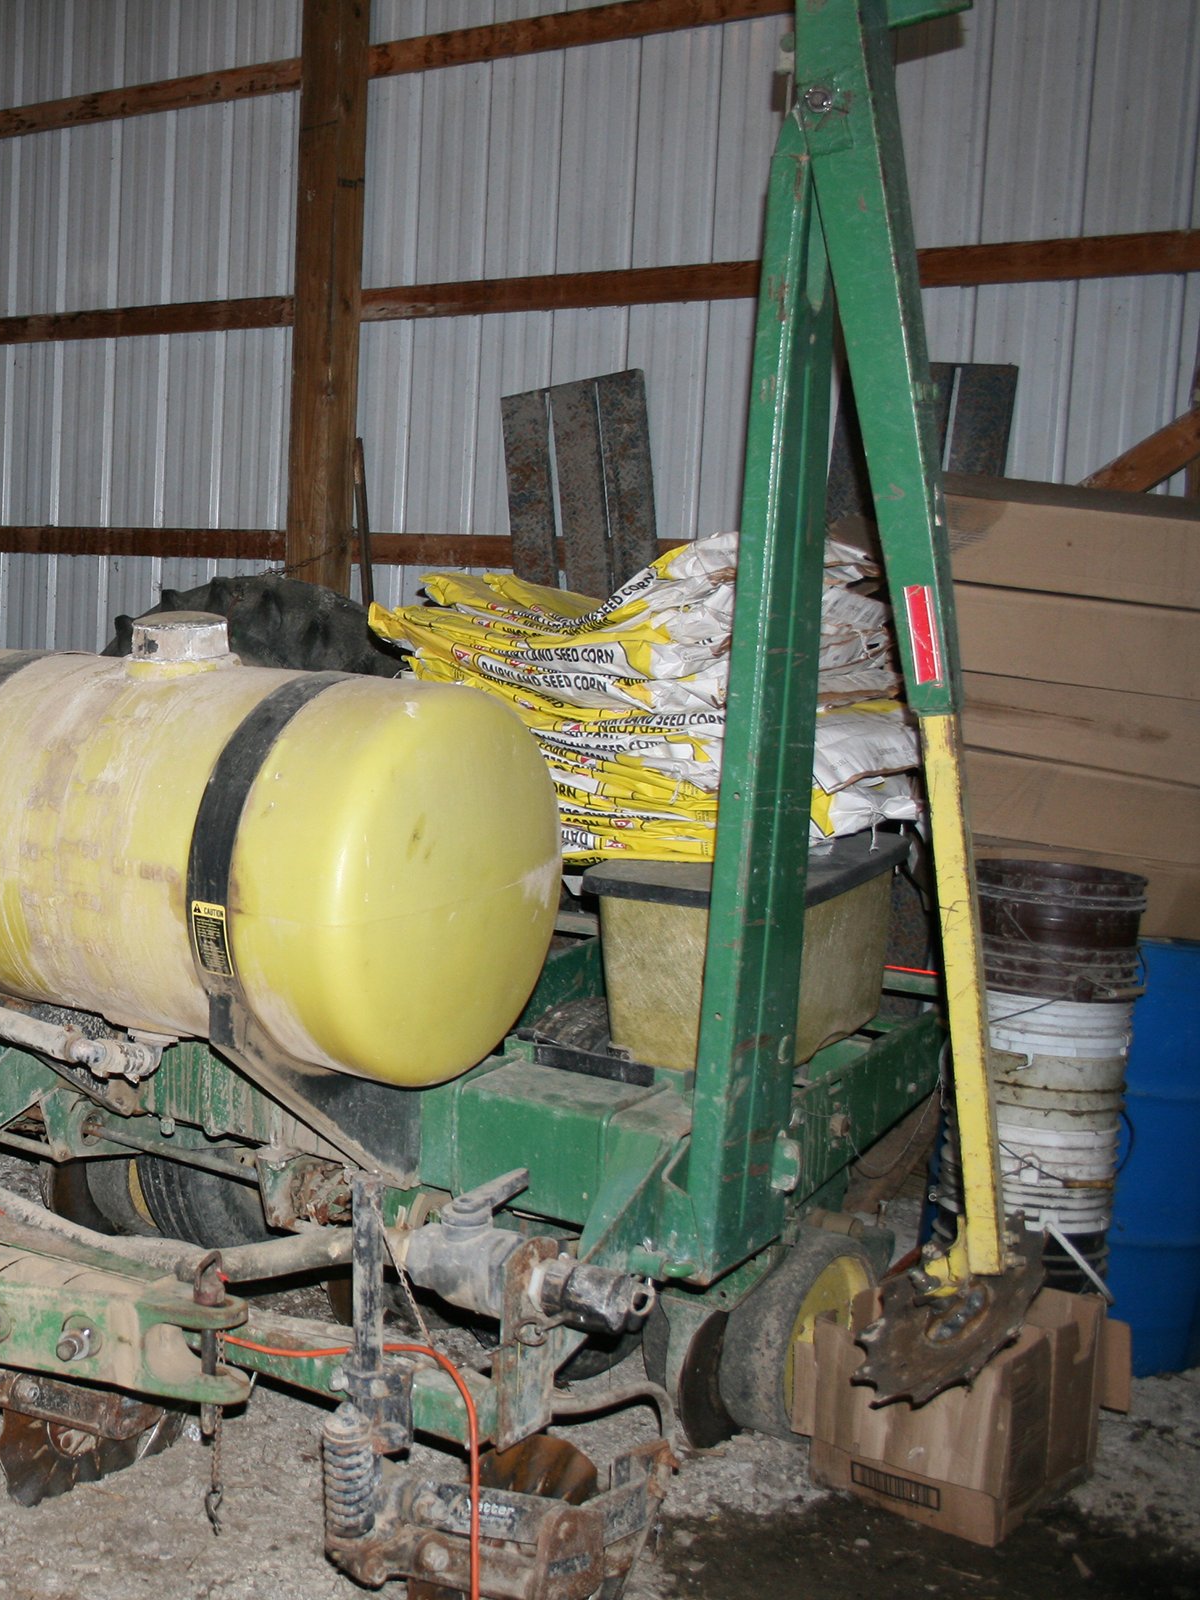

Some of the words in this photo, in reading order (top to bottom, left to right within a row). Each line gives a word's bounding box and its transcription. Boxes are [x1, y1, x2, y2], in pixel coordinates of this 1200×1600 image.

[596, 595, 624, 617] SEED
[622, 571, 656, 597] CORN
[554, 648, 579, 663] SEED
[580, 648, 615, 664] CORN
[481, 661, 542, 687] DAIRYLAND
[541, 674, 572, 688] SEED
[573, 675, 607, 693] CORN
[656, 714, 686, 727] SEED
[203, 907, 224, 918] CAUTION
[466, 1498, 515, 1516] tter
